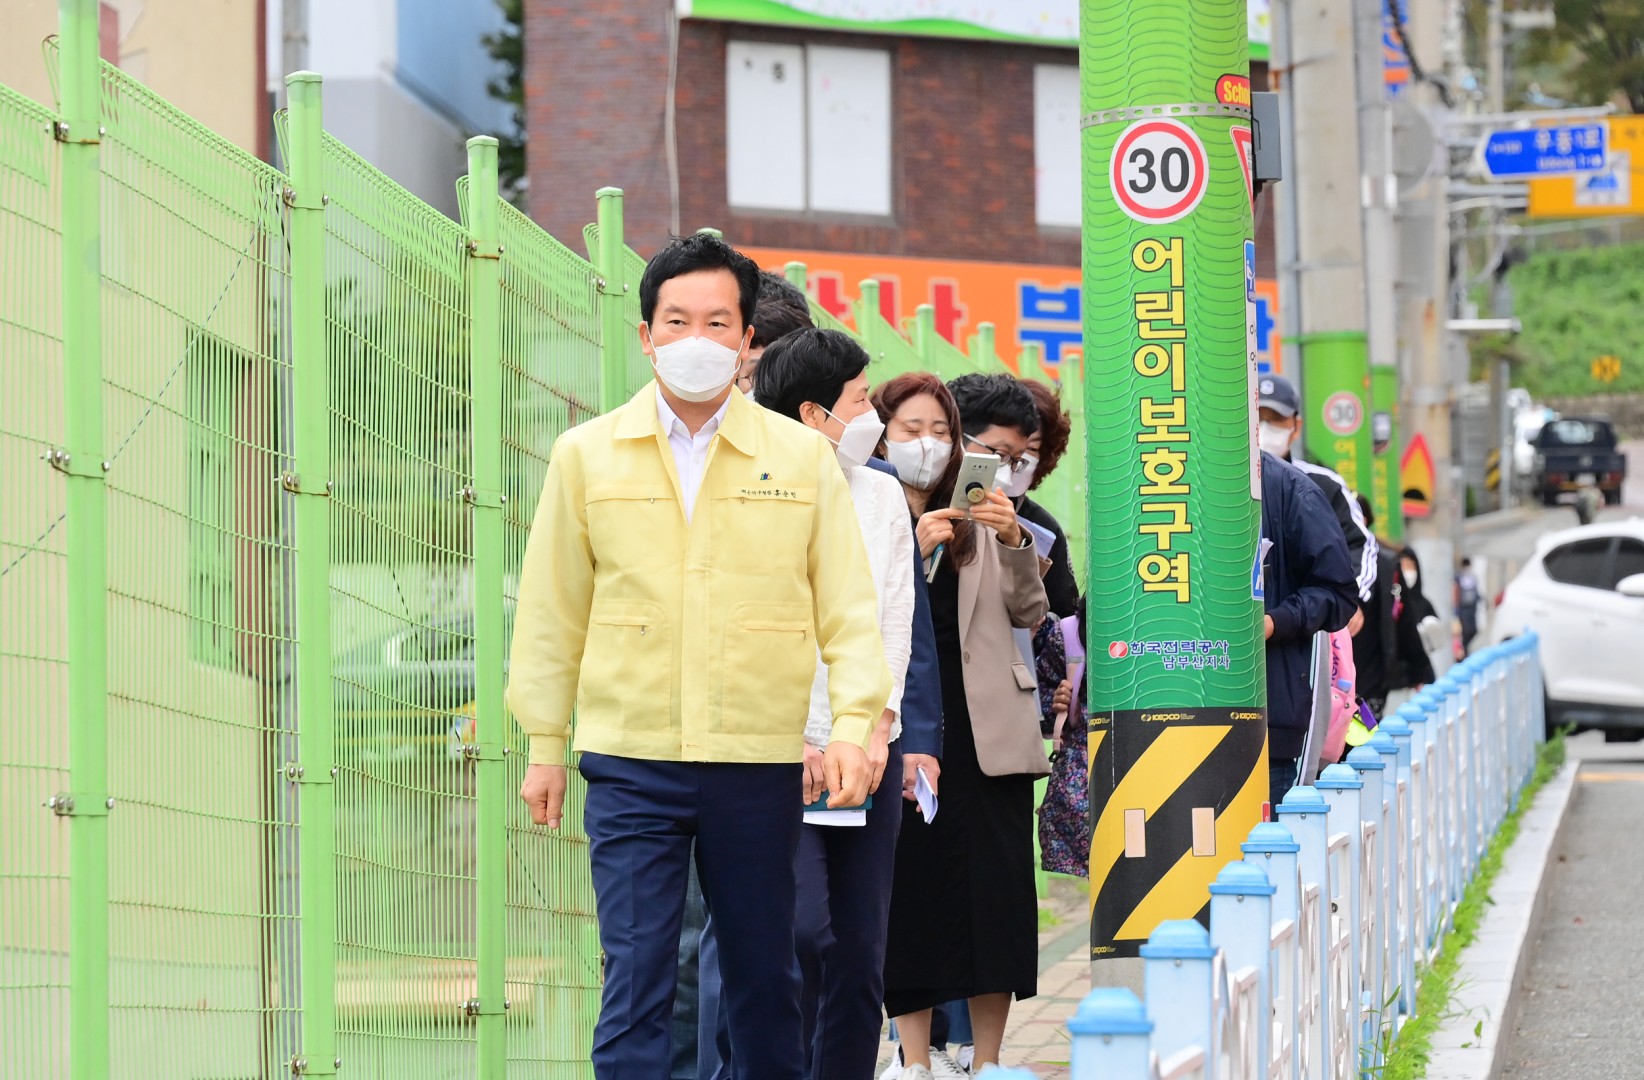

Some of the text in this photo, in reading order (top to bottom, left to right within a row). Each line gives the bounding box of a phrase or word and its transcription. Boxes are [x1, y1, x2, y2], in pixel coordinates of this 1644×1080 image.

[1128, 147, 1190, 194] 30
[1132, 236, 1193, 604] 어린이보호구역
[1130, 640, 1229, 656] 한국전력공사
[1163, 656, 1230, 670] 남부산지사
